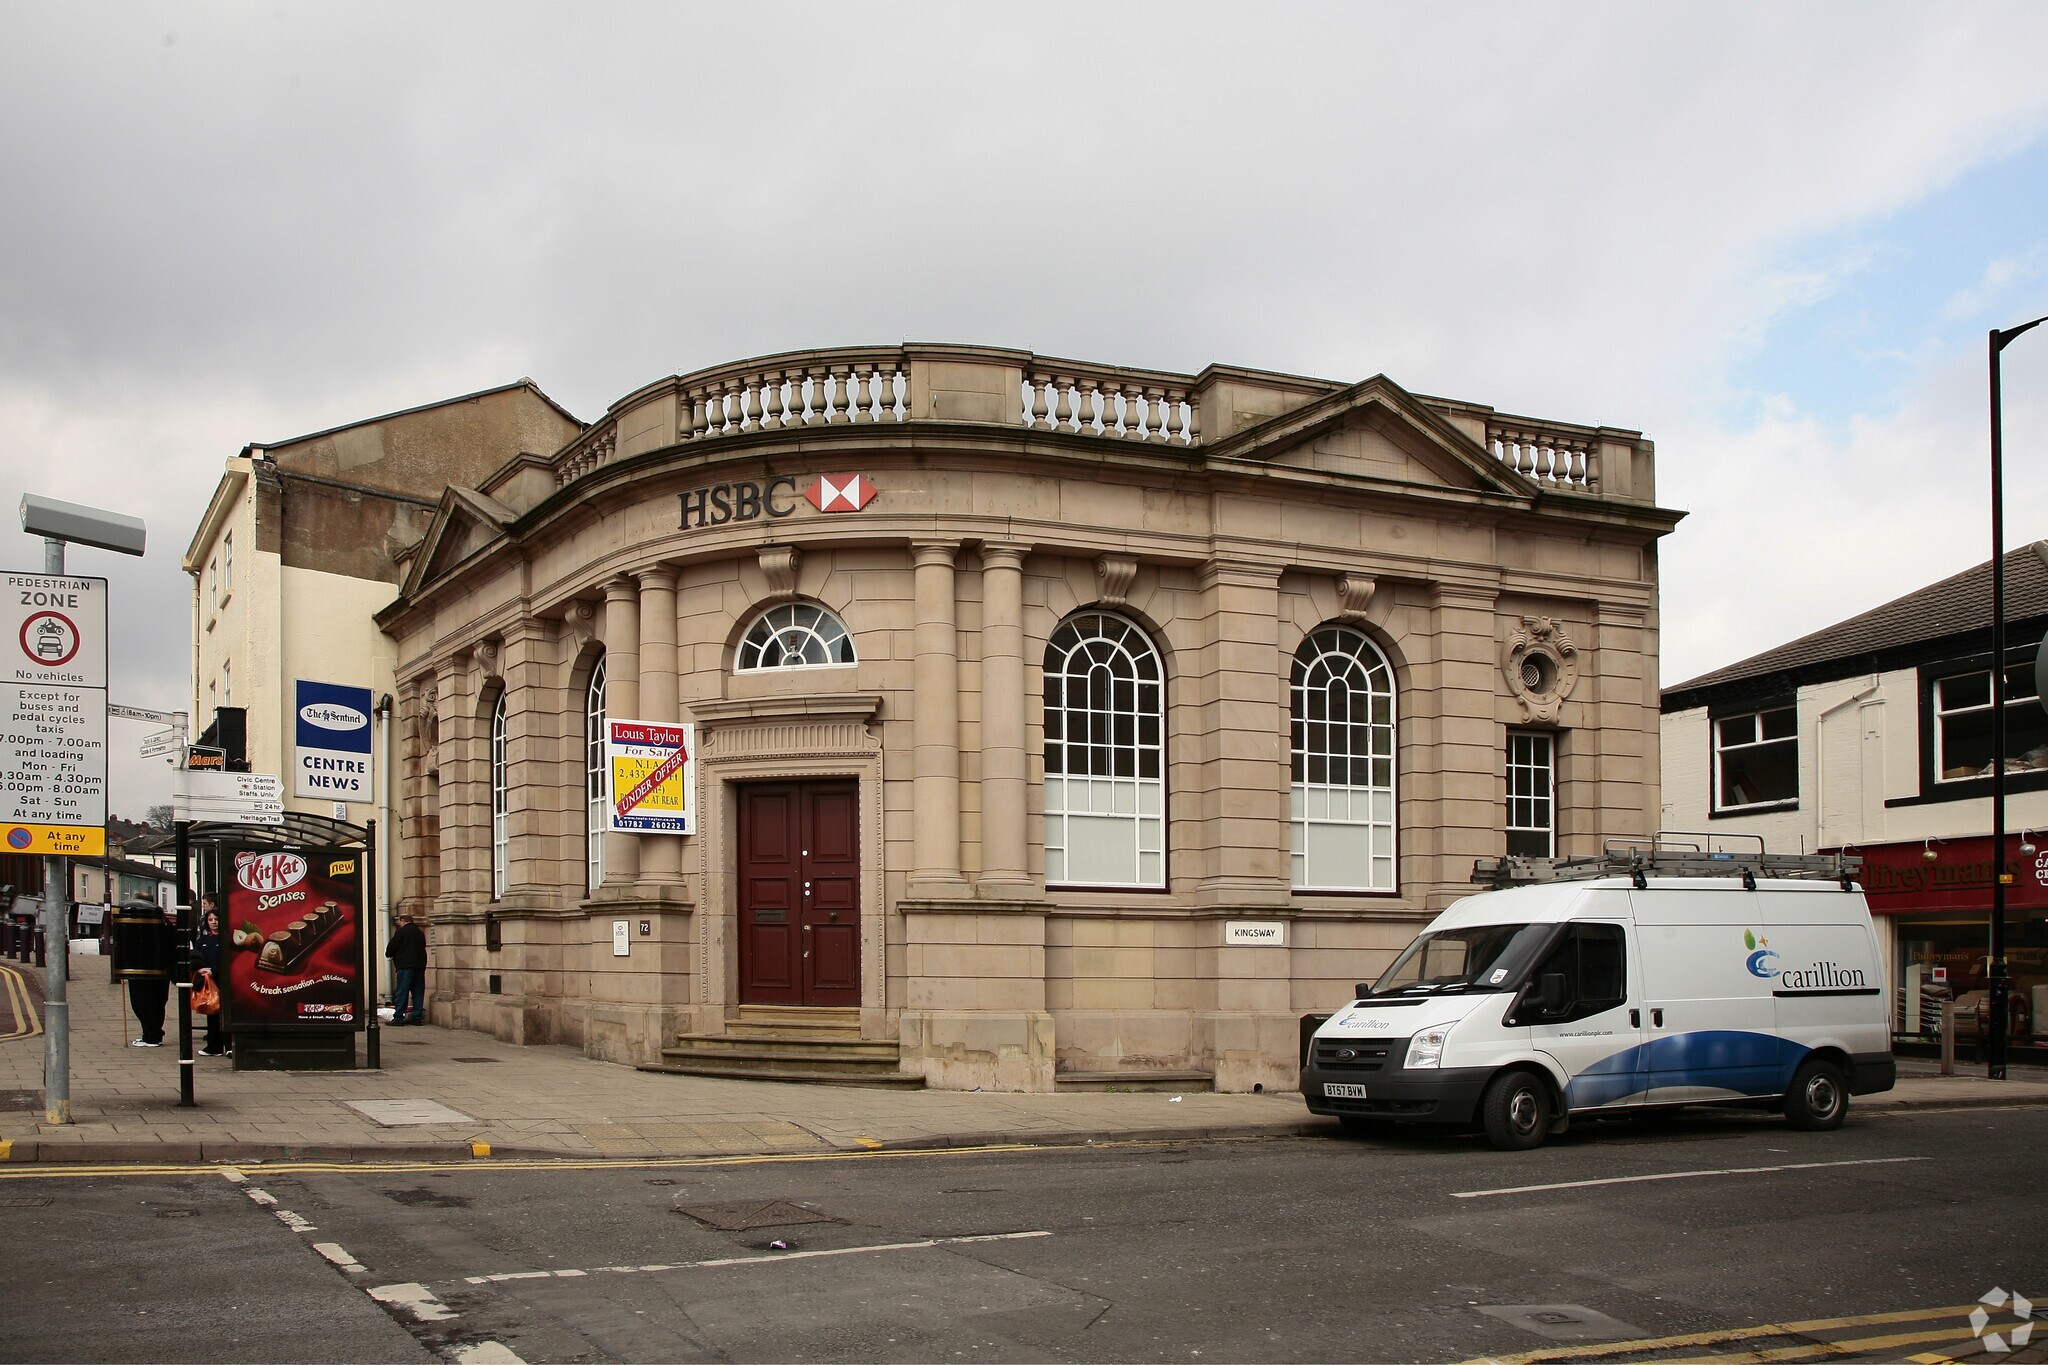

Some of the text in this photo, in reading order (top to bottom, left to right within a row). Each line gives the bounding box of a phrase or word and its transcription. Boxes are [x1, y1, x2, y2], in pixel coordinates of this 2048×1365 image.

[678, 477, 796, 530] HSBC
[8, 577, 90, 591] PEDESTRIAN
[20, 591, 78, 608] ZONE
[16, 670, 84, 683] No vehicles
[19, 690, 80, 702] Except for
[20, 701, 79, 713] buses and
[12, 712, 86, 727] pedal cycles
[306, 708, 361, 724] The Sentinel
[36, 724, 65, 734] taxis
[615, 725, 681, 746] Louis Taylor
[56, 738, 102, 748] 7.00am
[15, 749, 84, 762] and loading
[624, 746, 674, 757] For Sale
[22, 761, 48, 771] Mon
[61, 763, 76, 772] Fri
[189, 755, 224, 766] Mars
[303, 756, 365, 773] CENTRE
[655, 753, 683, 782] OFFER
[55, 773, 102, 785] 4.30pm
[309, 774, 360, 791] NEWS
[20, 795, 41, 805] Sat
[54, 797, 77, 807] Sun
[621, 779, 652, 811] UNDER
[661, 795, 678, 805] REAR
[13, 808, 82, 821] At any time
[240, 814, 267, 822] Heritage
[619, 819, 681, 830] 01782 260222
[47, 831, 86, 843] At any
[53, 842, 80, 851] time
[246, 855, 299, 889] KitKat
[331, 862, 354, 874] new
[257, 891, 306, 912] Senses
[640, 923, 649, 932] 72
[1234, 928, 1276, 938] KINGSWAY
[1912, 951, 1969, 962] Palfreyman's
[1782, 961, 1866, 989] carillion
[260, 984, 283, 995] break
[282, 979, 315, 994] sensation
[1347, 1018, 1390, 1029] carillion
[1327, 1085, 1363, 1097] BT57 BVM
